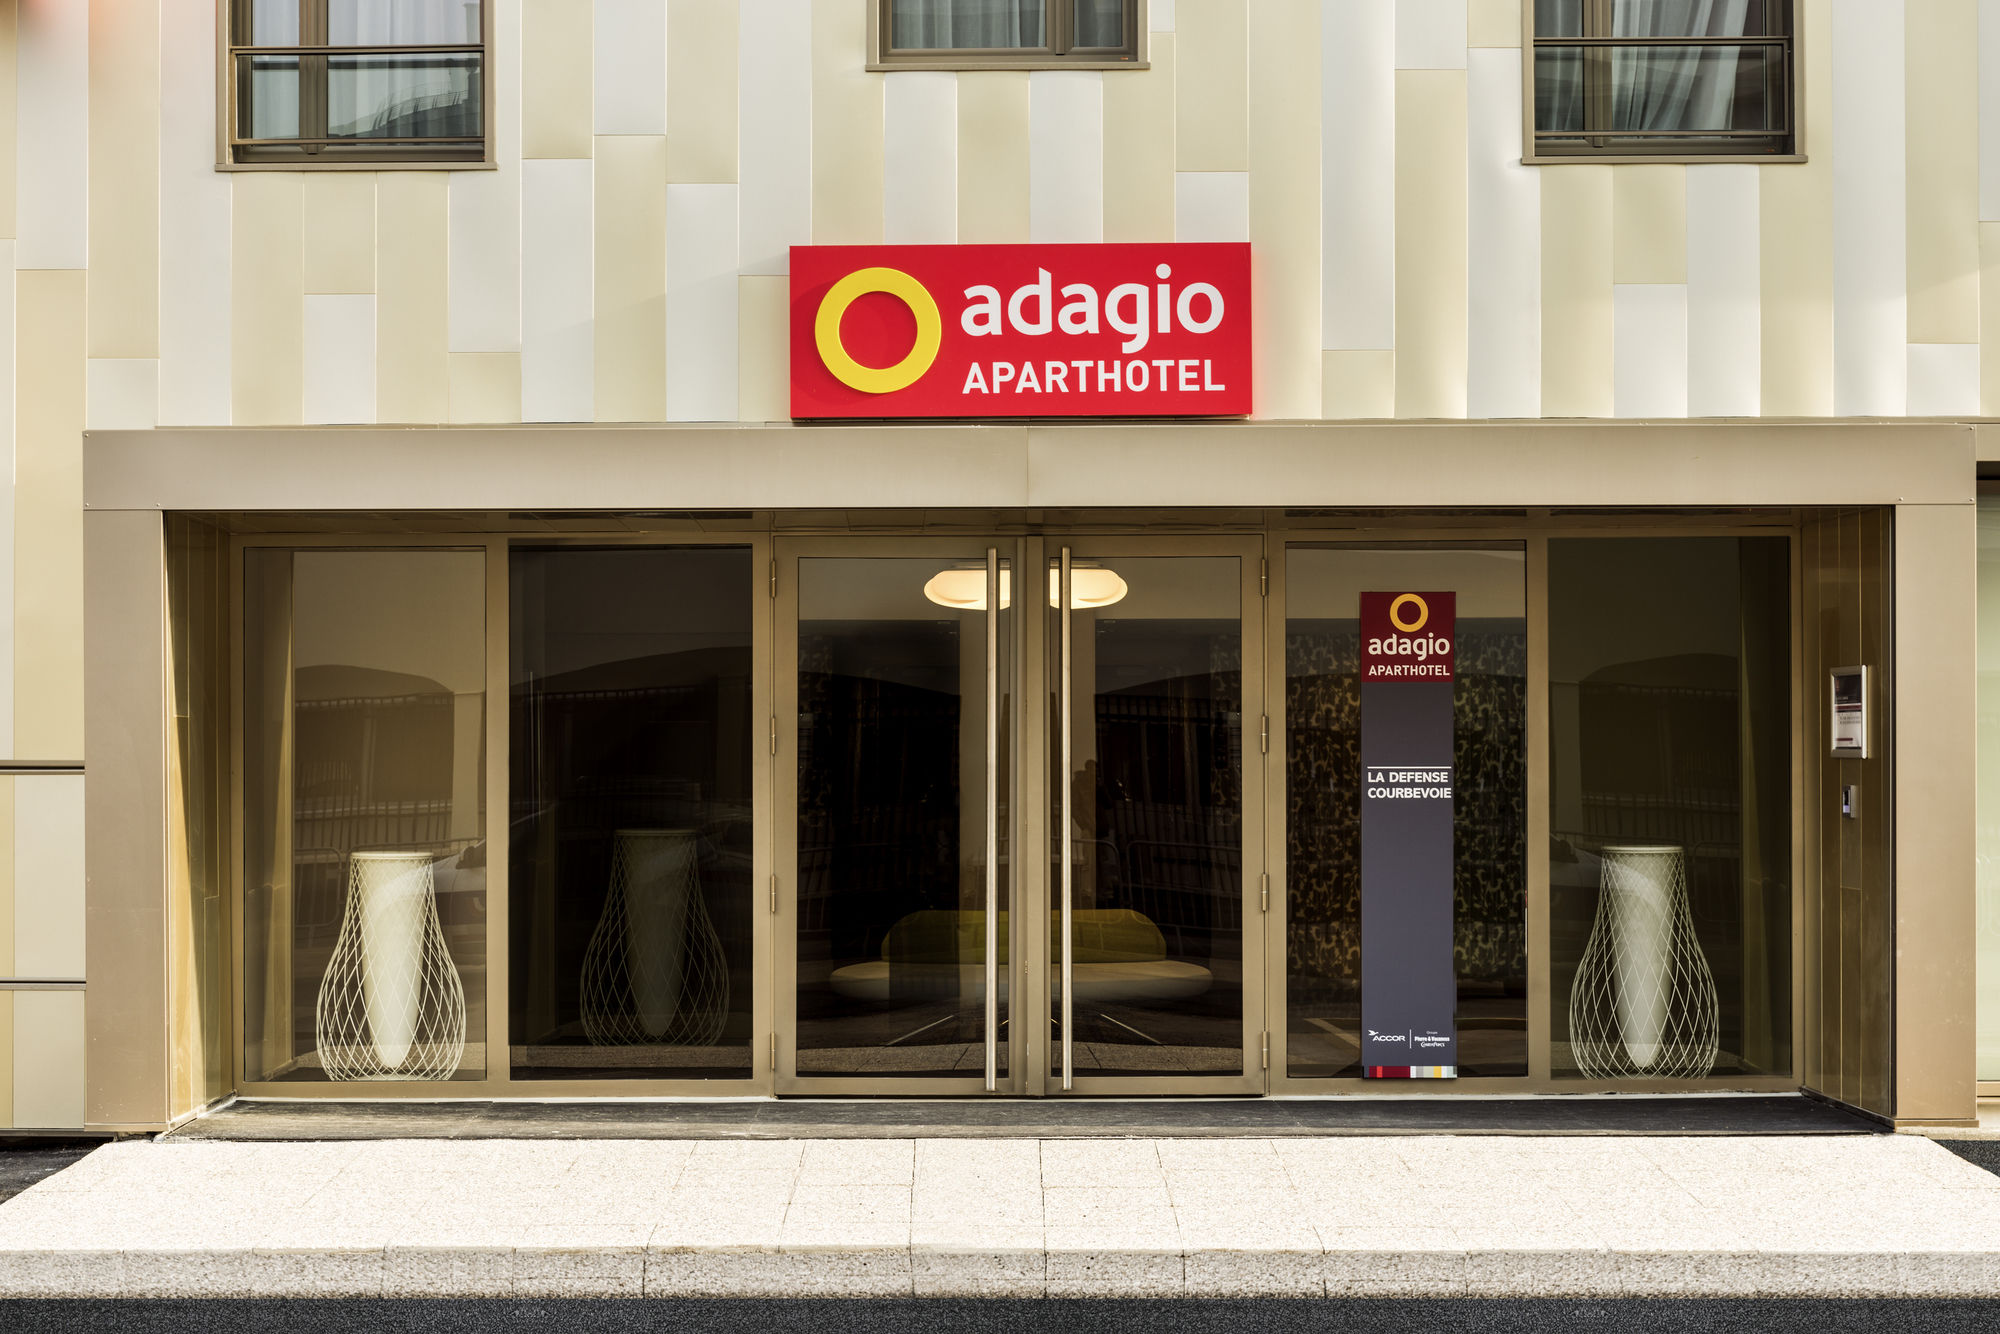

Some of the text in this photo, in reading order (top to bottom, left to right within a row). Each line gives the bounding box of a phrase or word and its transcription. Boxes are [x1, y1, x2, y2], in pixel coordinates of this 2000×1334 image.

[960, 263, 1225, 354] adagio
[962, 359, 1226, 394] APARTHOTEL
[1367, 632, 1451, 662] adagio
[1368, 664, 1451, 676] APARTHOTEL
[1367, 771, 1449, 783] LA DEFENSE
[1367, 787, 1452, 799] COURBEVOIE
[1372, 1034, 1406, 1042] ACCOR
